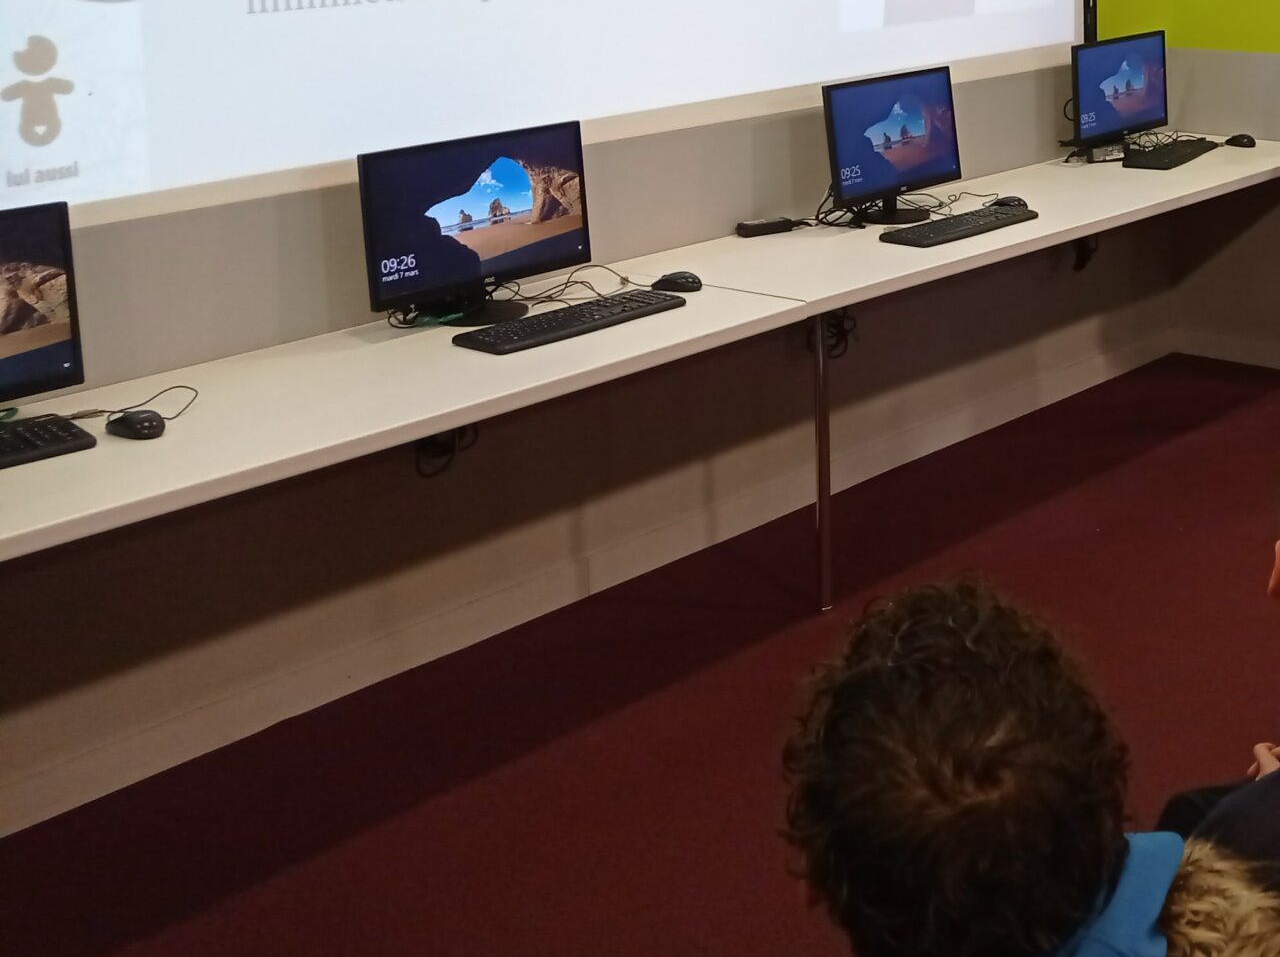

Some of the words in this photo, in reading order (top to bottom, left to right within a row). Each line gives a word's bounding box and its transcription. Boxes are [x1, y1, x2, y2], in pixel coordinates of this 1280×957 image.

[6, 168, 31, 188] lui
[34, 160, 80, 184] aussi
[381, 254, 417, 273] 09:26
[382, 273, 400, 282] mardi
[404, 269, 420, 277] mars
